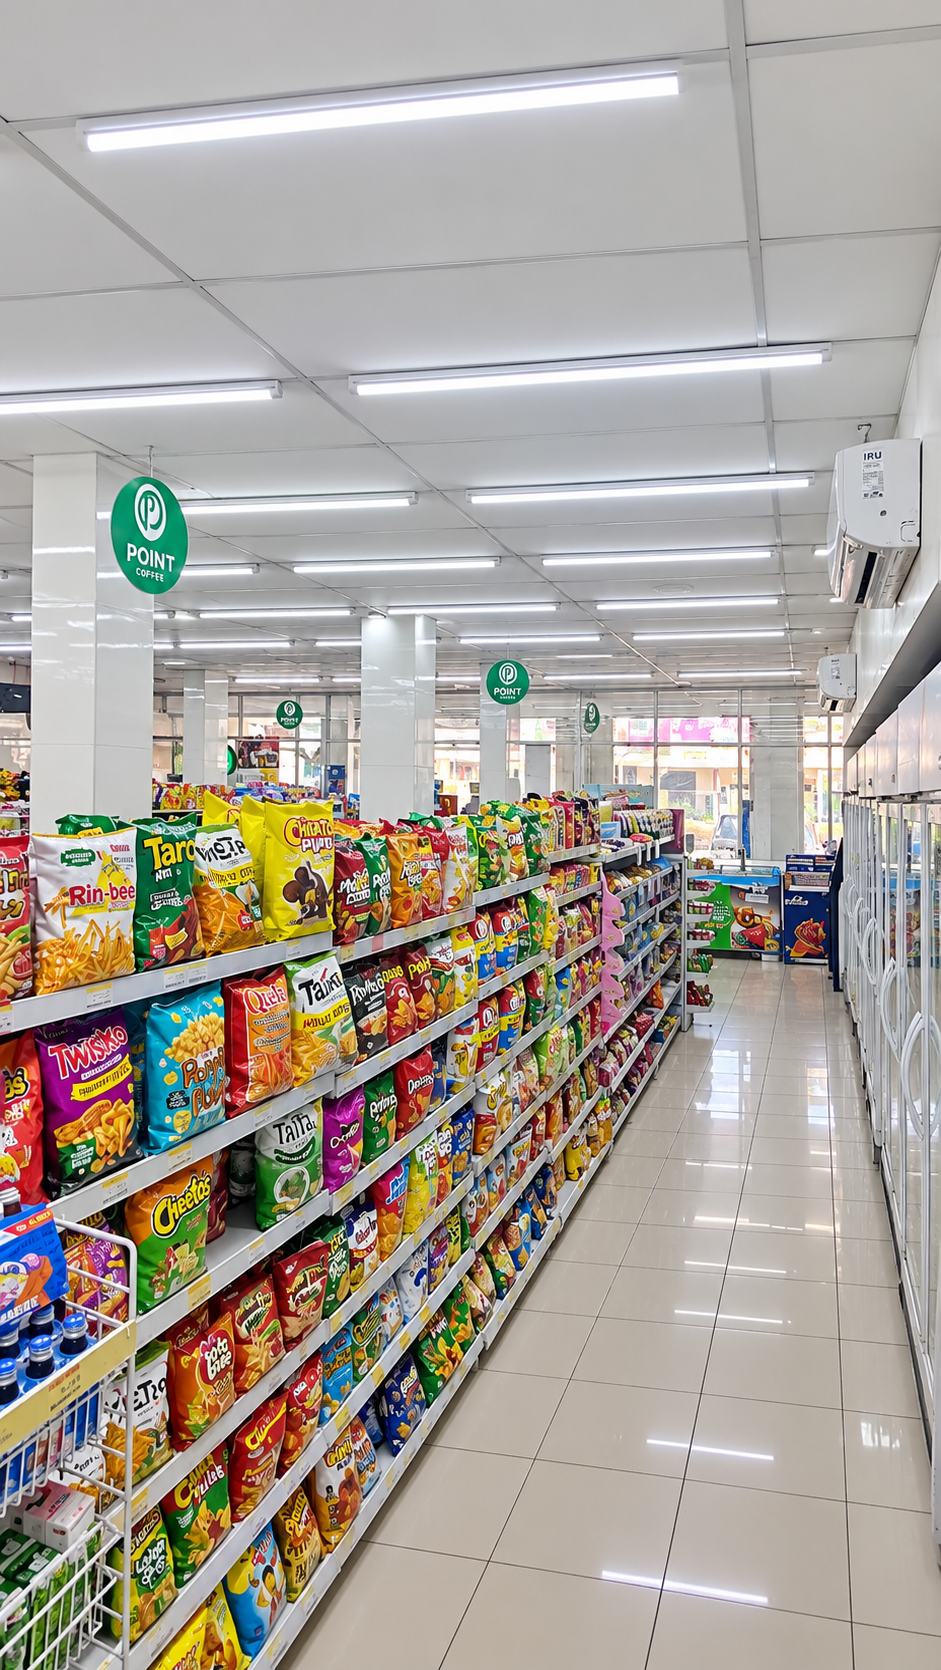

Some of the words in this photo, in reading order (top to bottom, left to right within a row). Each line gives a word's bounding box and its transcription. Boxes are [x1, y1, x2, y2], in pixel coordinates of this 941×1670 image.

[863, 451, 882, 461] IRU
[127, 542, 175, 572] POINT
[135, 567, 164, 582] COFFEE
[493, 687, 521, 696] POINT
[143, 836, 196, 871] Taro
[68, 882, 136, 906] Rin-bee
